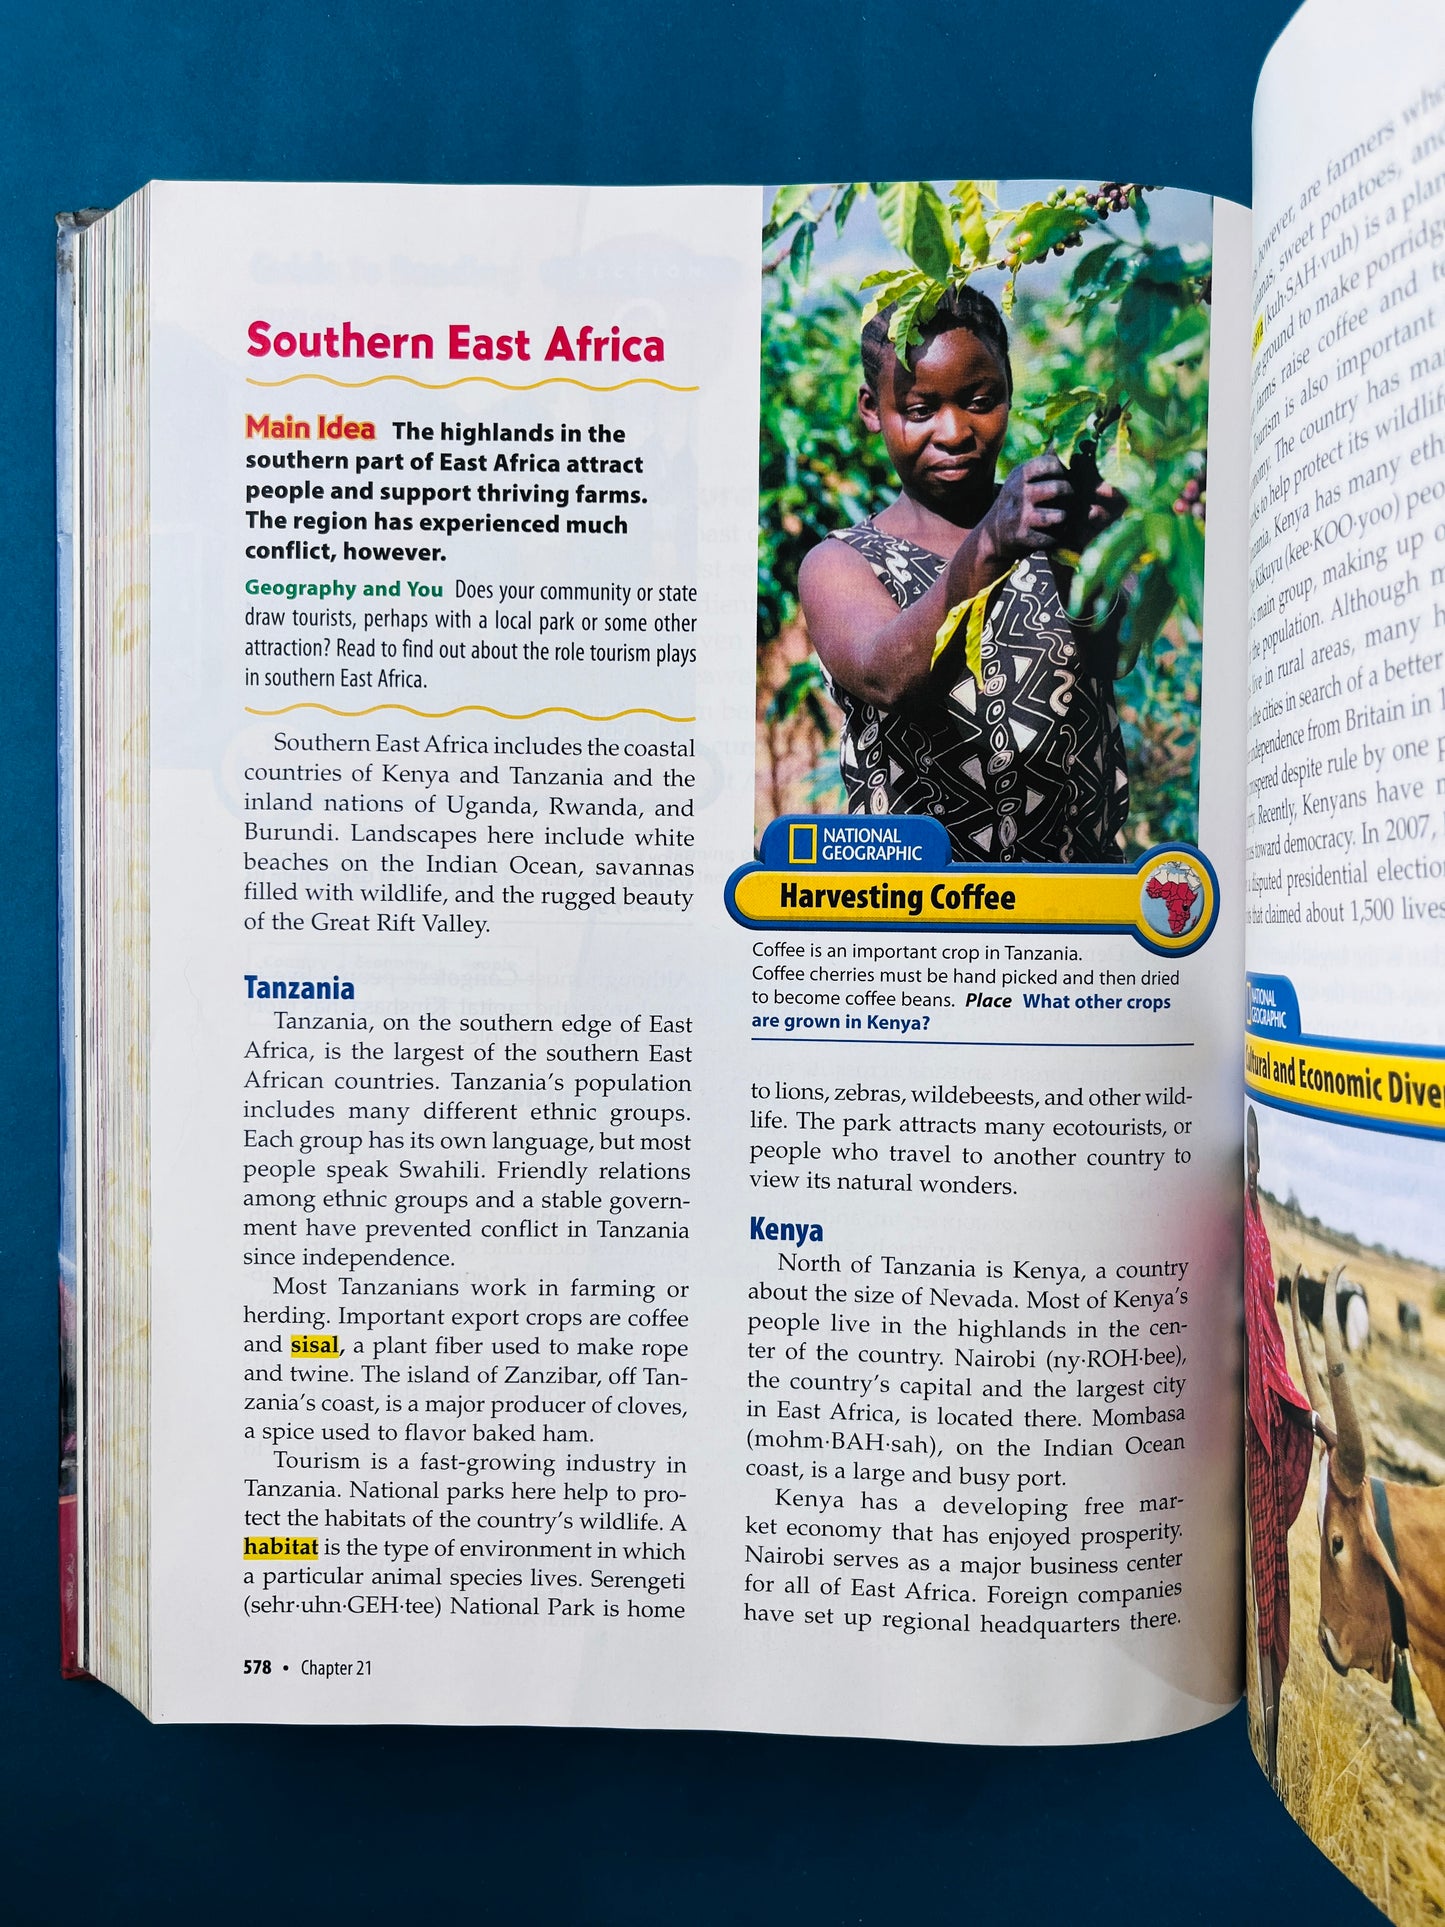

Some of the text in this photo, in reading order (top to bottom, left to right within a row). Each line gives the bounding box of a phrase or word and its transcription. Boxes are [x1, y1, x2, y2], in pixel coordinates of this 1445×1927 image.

[1300, 120, 1395, 210] are farmers
[1280, 162, 1402, 272] sweet potatoes,
[247, 320, 664, 362] Southern East Africa
[1281, 347, 1311, 384] raise
[1318, 307, 1369, 354] coffee
[1380, 269, 1418, 313] and
[1285, 397, 1295, 419] is
[1300, 373, 1329, 406] also
[1336, 307, 1435, 381] important
[245, 413, 625, 446] Main Idea The highlands in the
[1275, 372, 1400, 463] The country has
[246, 450, 643, 474] southern part of East Africa attract
[246, 480, 647, 508] people and support thriving farms.
[1274, 503, 1310, 539] Kenya
[1315, 484, 1341, 512] has
[1349, 456, 1401, 495] many
[245, 510, 627, 536] The region has experienced much
[246, 540, 446, 563] conflict, however.
[1278, 531, 1424, 615] group, making up
[245, 579, 697, 606] Geography and You Does your community or state
[1262, 570, 1420, 660] population. Although
[1299, 651, 1444, 708] search of a better
[1308, 693, 1431, 742] from Britain in
[275, 732, 695, 757] Southern East Africa includes the coastal
[1281, 738, 1429, 788] despite rule by one
[1258, 798, 1297, 826] Recently,
[1302, 789, 1367, 819] Kenyans
[1376, 780, 1424, 804] have
[823, 827, 902, 843] NATIONAL
[1283, 813, 1437, 854] democracy. In 2007,
[822, 845, 923, 861] GEOGRAPHIC
[1287, 859, 1368, 896] presidential
[780, 882, 1016, 916] Harvesting Coffee
[1265, 901, 1301, 924] claimed
[1306, 901, 1344, 923] about
[1352, 897, 1394, 925] 1,500
[753, 942, 1082, 963] Coffee is an important crop in Tanzania.
[244, 975, 354, 1000] Tanzania
[752, 965, 1179, 988] Coffee cherries must be hand picked and then dried
[752, 989, 1171, 1013] to become coffee beans. Place What other crops
[1251, 988, 1276, 1007] NATIONAL
[752, 1014, 930, 1034] are grown in Kenya?
[1251, 1007, 1287, 1029] GEOGRAPHIC
[1273, 1056, 1445, 1110] and Economic Dive
[751, 1216, 823, 1248] Kenya
[244, 1335, 688, 1362] and sisal, a plant fiber used to make rope
[775, 1488, 1183, 1522] Kenya has a developing free mar-
[244, 1537, 686, 1562] habitat is the type of environment in which
[744, 1603, 1180, 1639] have set up regional headquarters there.
[244, 1659, 370, 1679] 578 Chapter 21
